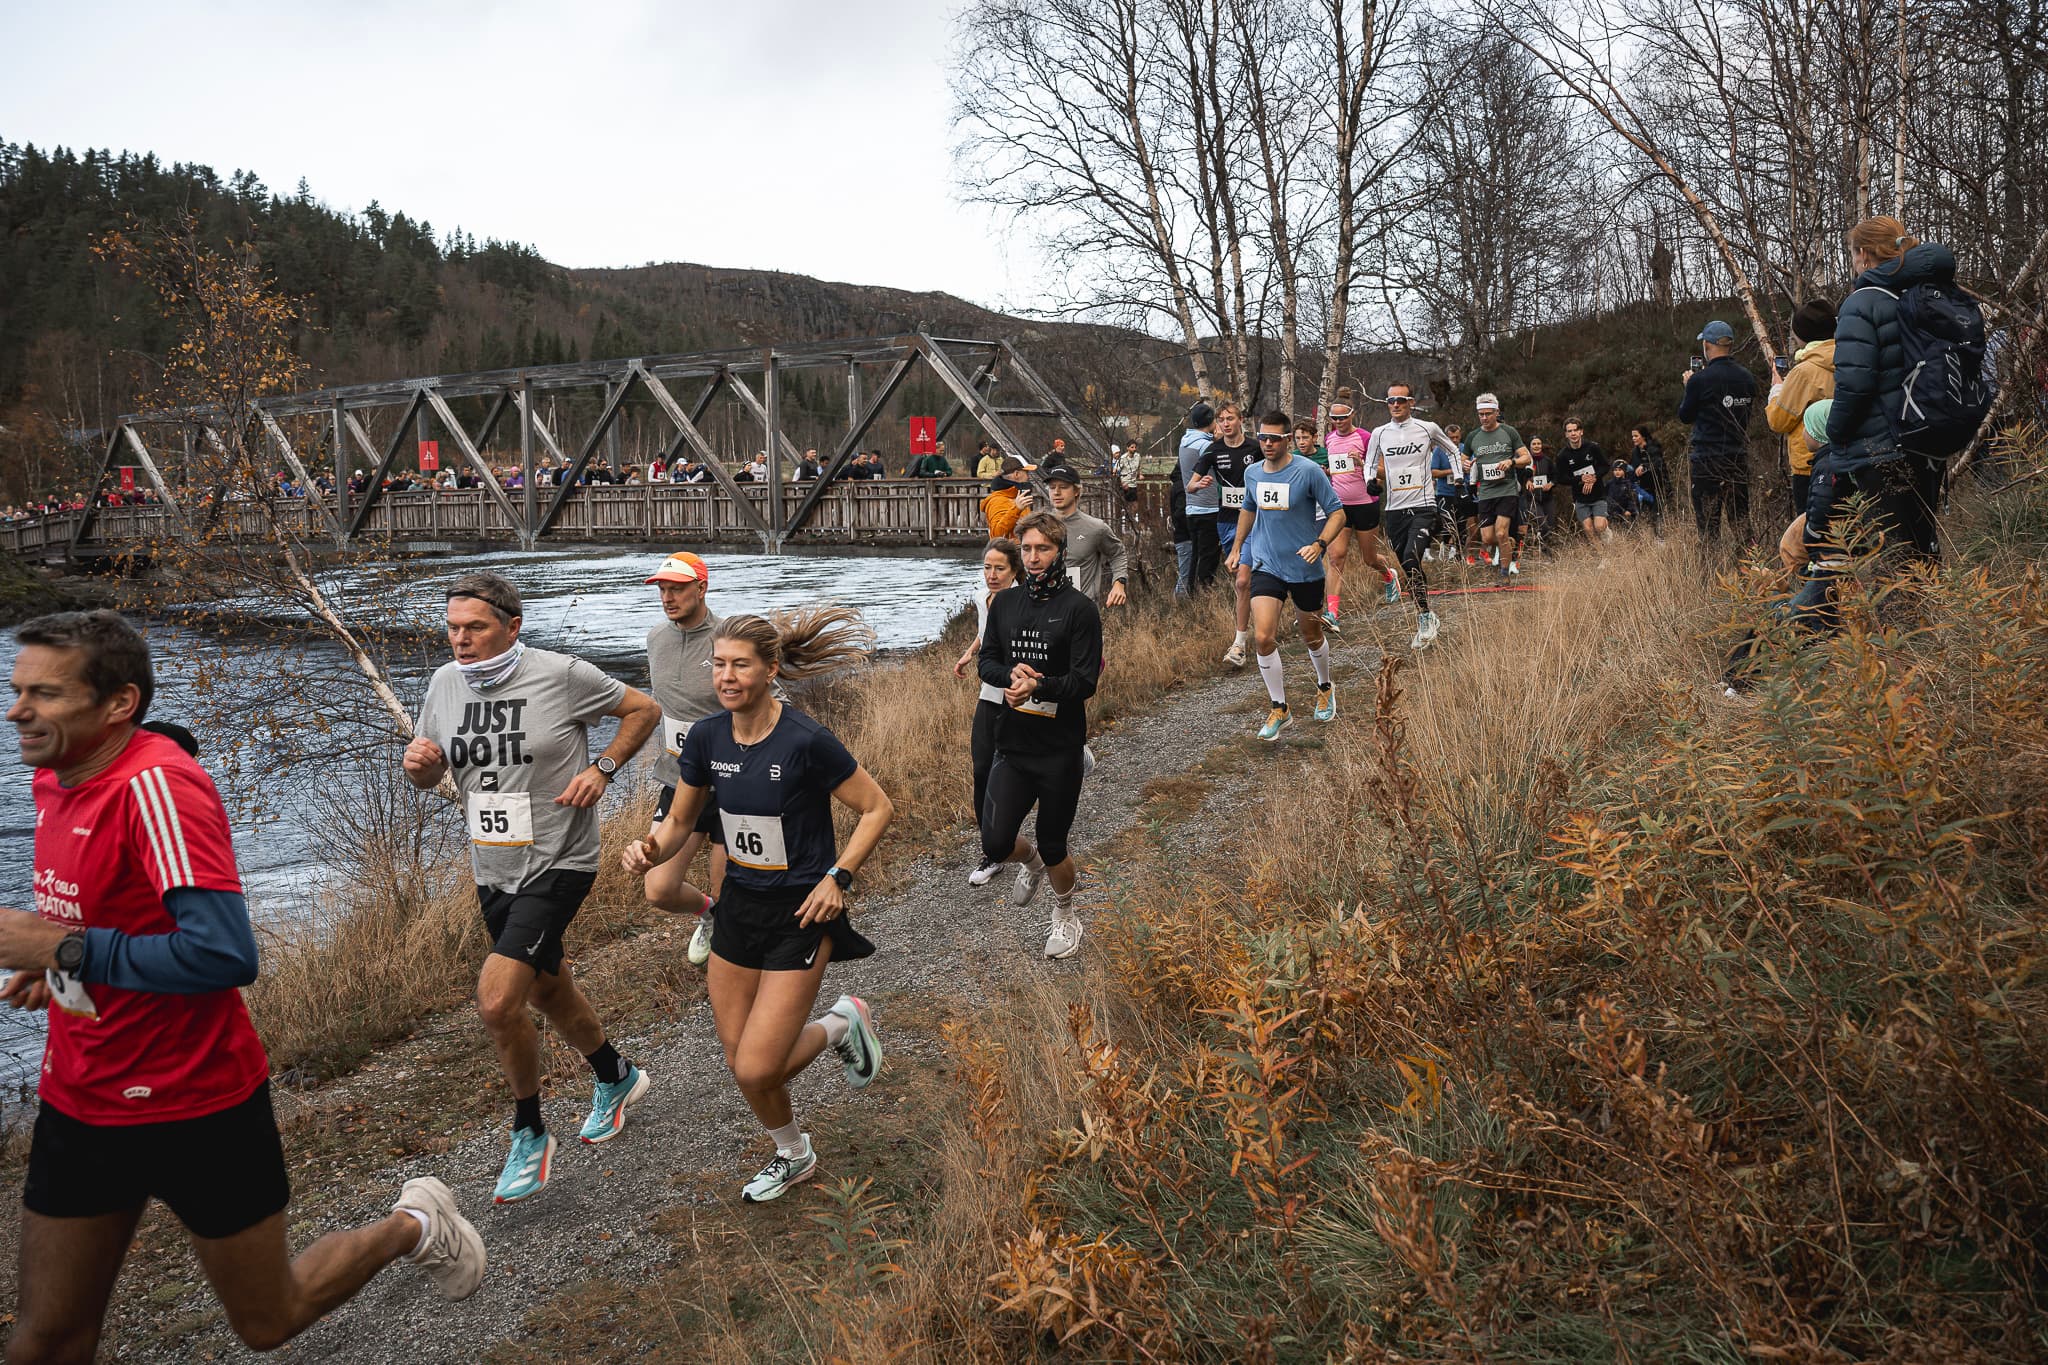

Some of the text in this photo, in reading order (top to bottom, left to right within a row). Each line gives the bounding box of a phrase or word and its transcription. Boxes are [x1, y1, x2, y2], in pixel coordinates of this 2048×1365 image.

[1334, 460, 1347, 470] 38
[1398, 474, 1412, 485] 37
[1263, 491, 1279, 503] 54
[1011, 640, 1048, 650] RUNNING
[1012, 651, 1048, 661] DIVISION
[457, 699, 527, 735] JUST
[451, 732, 534, 768] DO IT.
[479, 810, 509, 833] 55
[735, 831, 763, 856] 46
